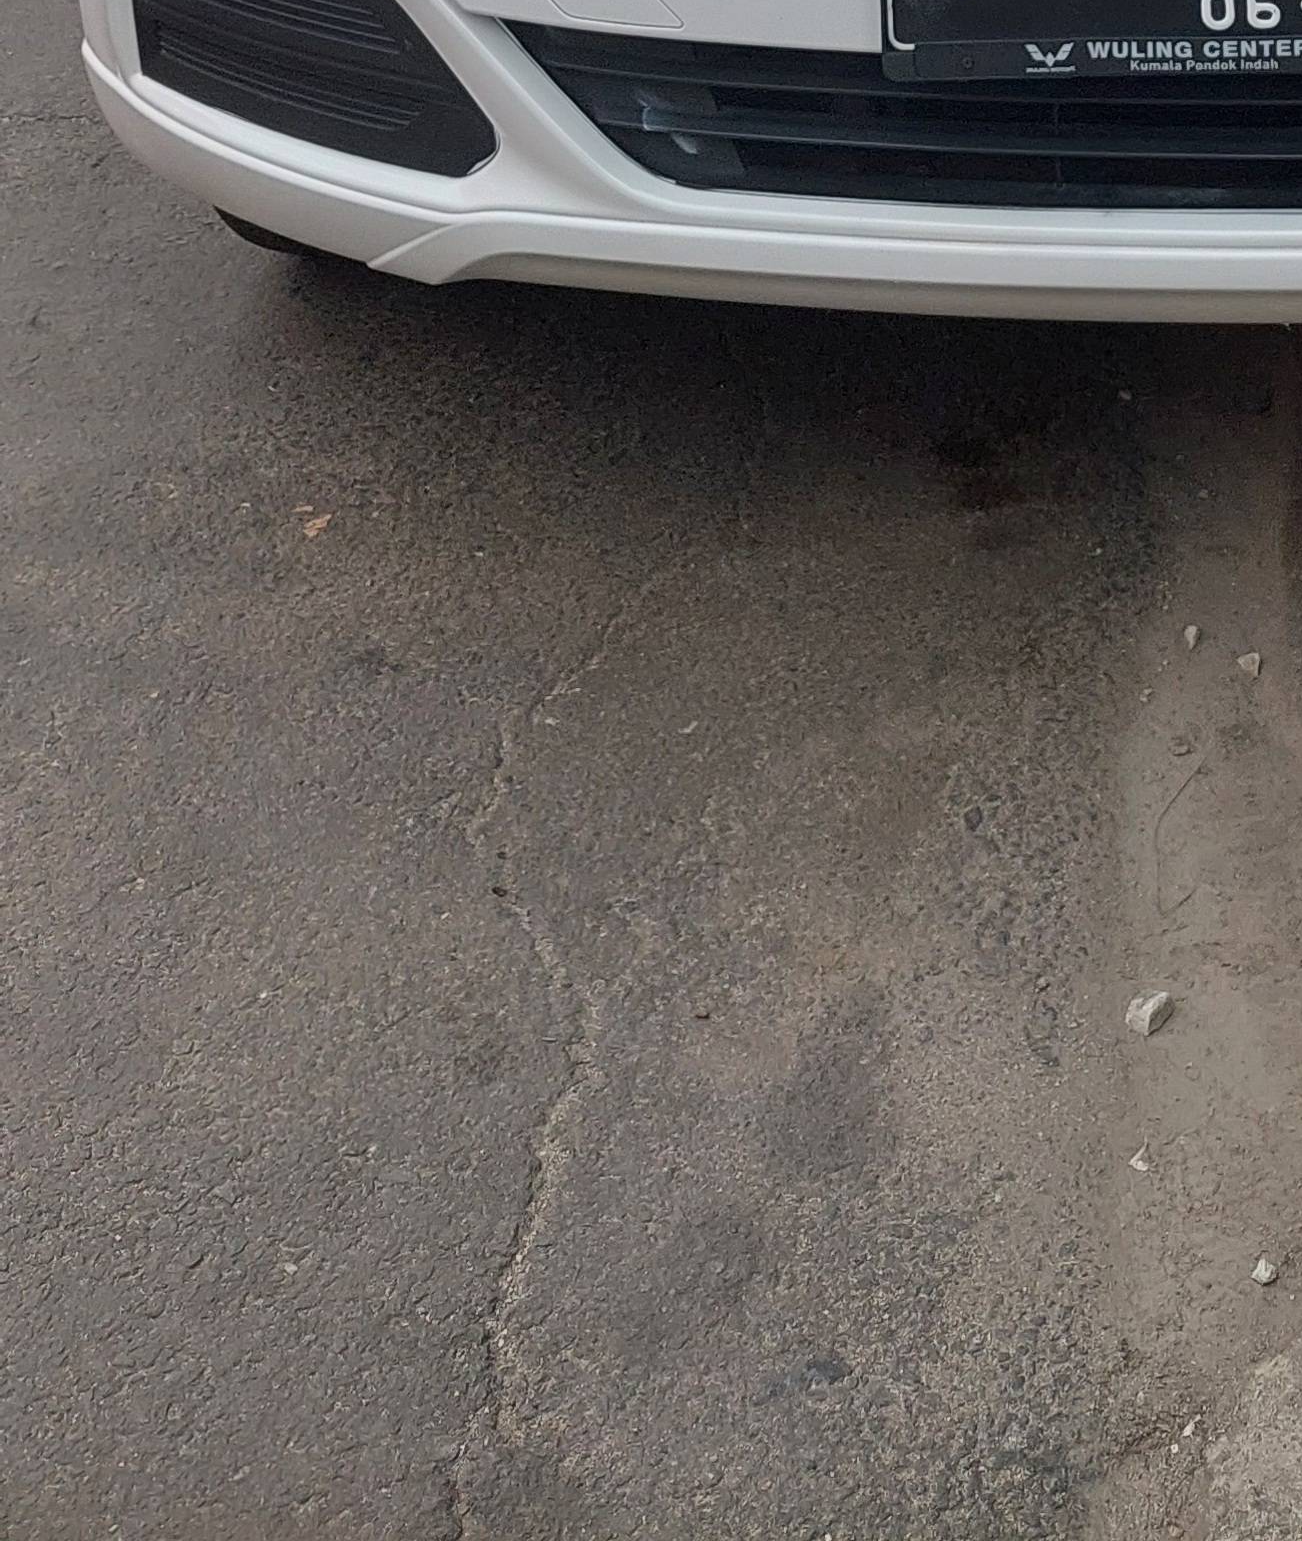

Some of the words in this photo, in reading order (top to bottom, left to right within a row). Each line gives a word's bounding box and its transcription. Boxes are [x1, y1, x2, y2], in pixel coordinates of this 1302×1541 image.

[1086, 40, 1193, 60] WULING
[1130, 60, 1182, 71] Kumala
[1186, 59, 1237, 71] Pondok
[1240, 59, 1279, 71] Indah
